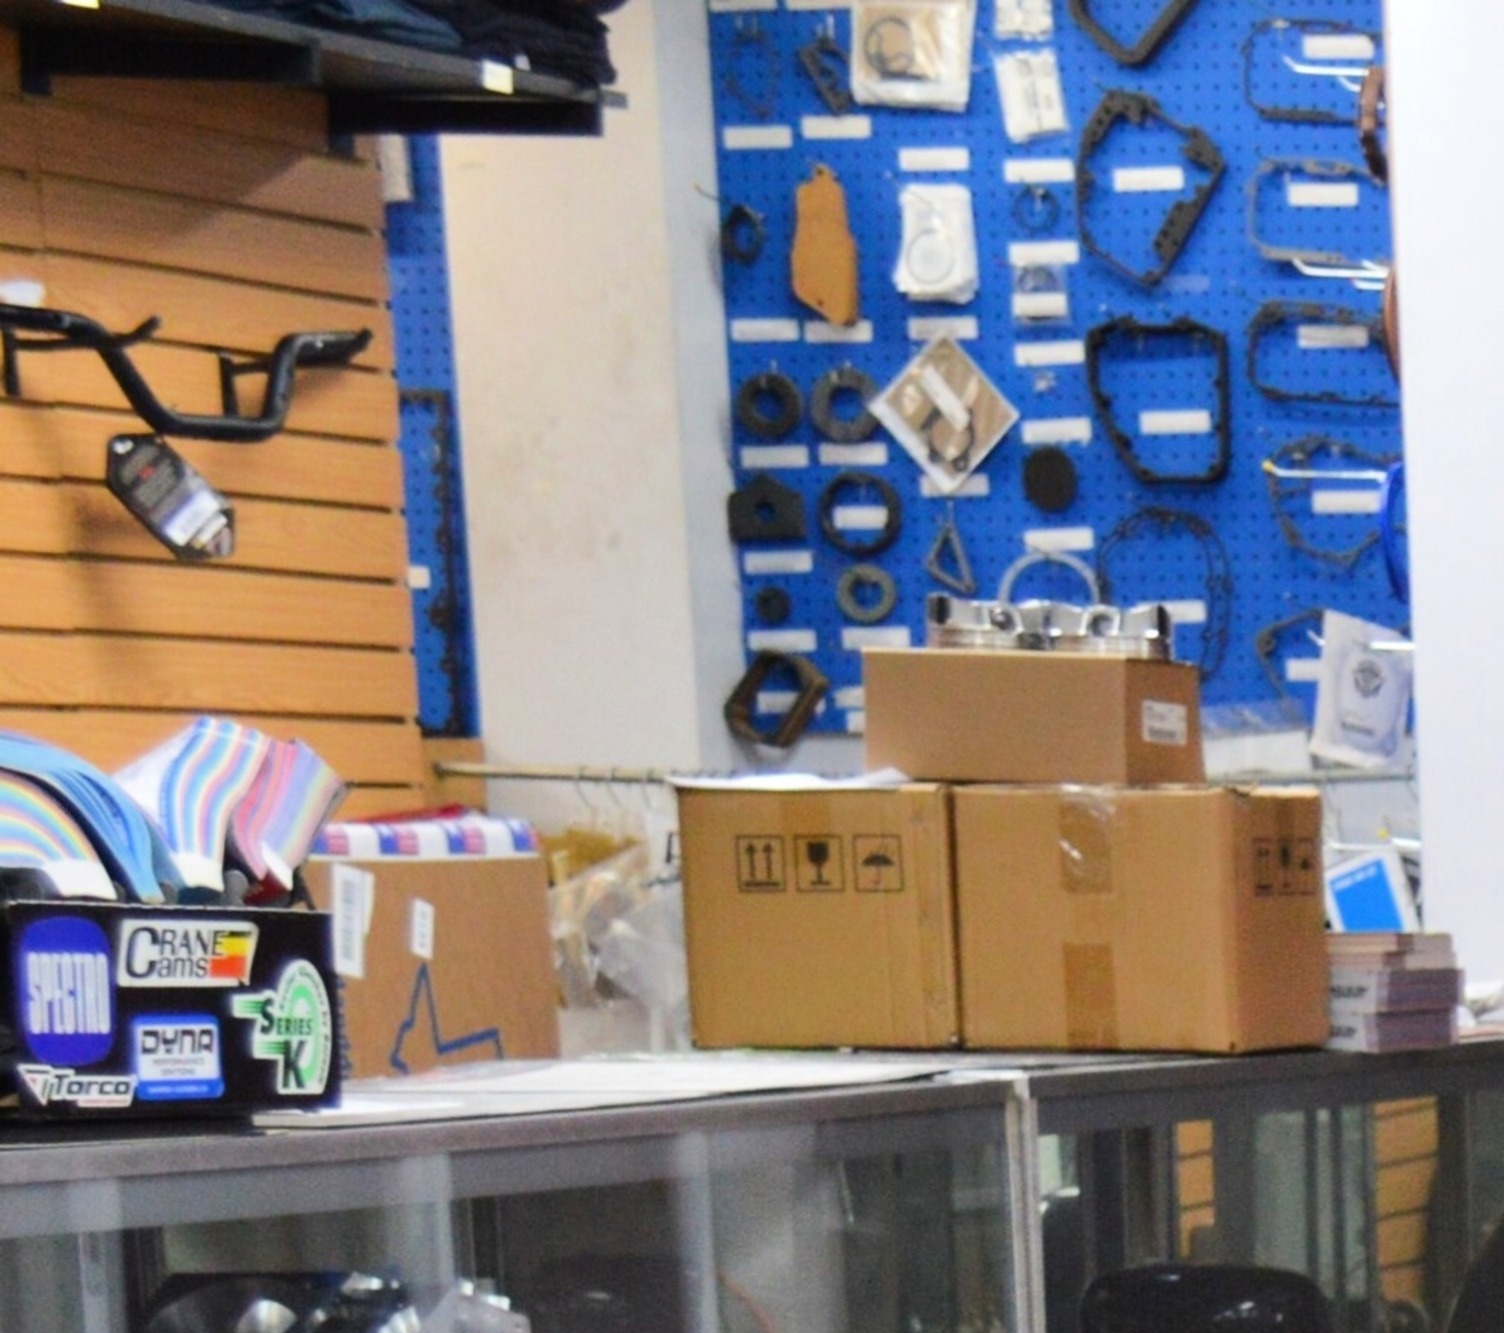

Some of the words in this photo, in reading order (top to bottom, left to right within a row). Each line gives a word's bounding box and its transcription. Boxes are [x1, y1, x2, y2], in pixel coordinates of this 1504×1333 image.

[126, 927, 224, 978] CRANE
[260, 999, 312, 1035] SERIES
[141, 1029, 214, 1055] DYNA
[282, 1040, 305, 1089] K
